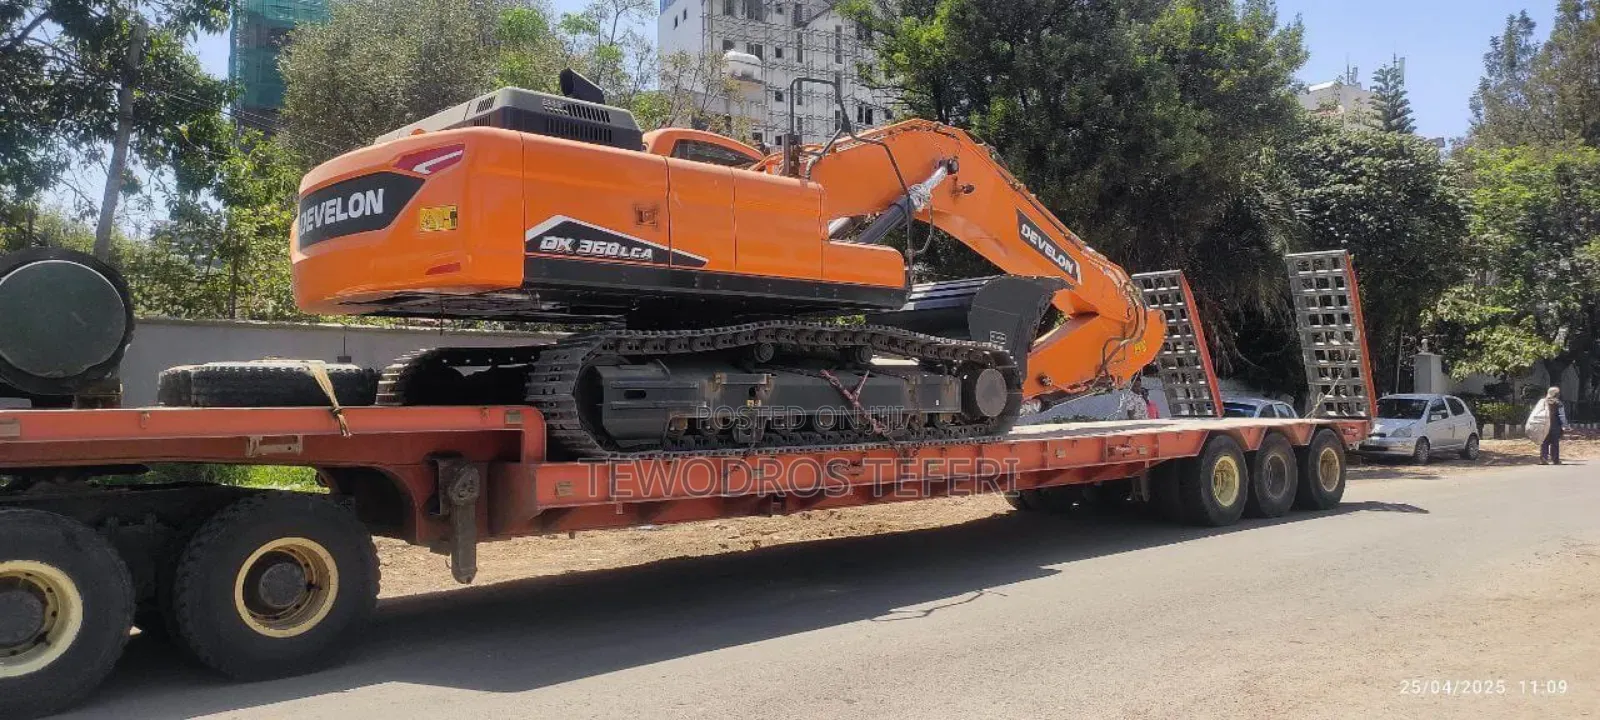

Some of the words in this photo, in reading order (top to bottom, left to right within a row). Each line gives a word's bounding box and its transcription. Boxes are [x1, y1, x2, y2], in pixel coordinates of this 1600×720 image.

[299, 188, 384, 237] DEVELON
[540, 236, 575, 254] DX
[1020, 223, 1076, 275] DEVELON
